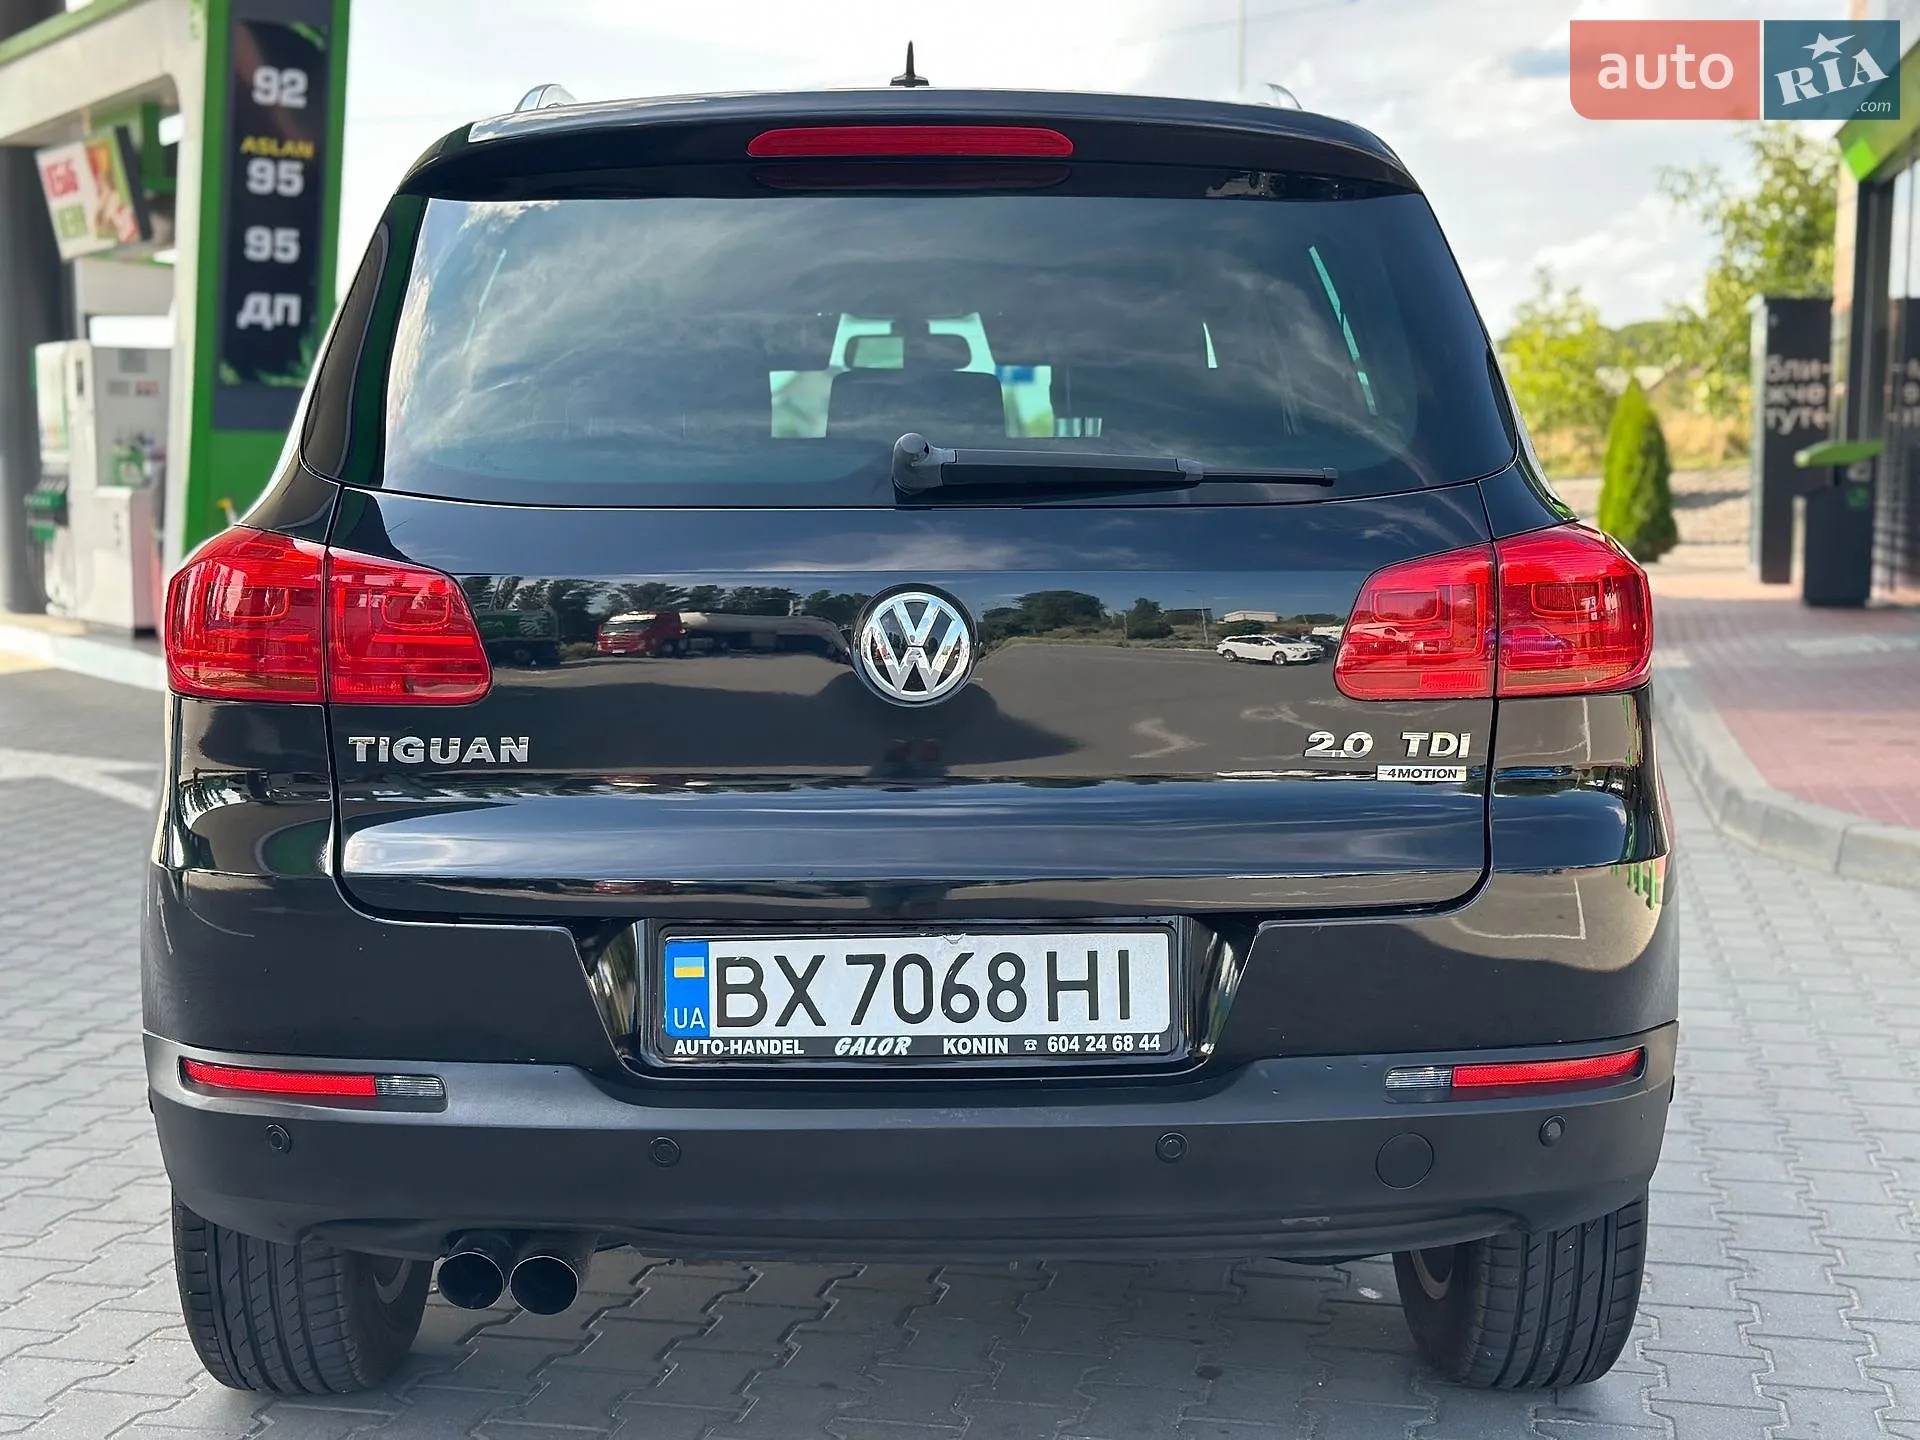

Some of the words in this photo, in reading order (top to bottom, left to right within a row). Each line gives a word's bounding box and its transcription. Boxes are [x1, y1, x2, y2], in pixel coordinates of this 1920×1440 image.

[252, 66, 309, 109] 92
[240, 135, 315, 159] ASLAN
[246, 157, 305, 197] 95
[244, 225, 301, 264] 95
[236, 292, 301, 331] ДП
[348, 736, 530, 764] TIGUAN
[1304, 731, 1374, 759] 2.0
[1402, 731, 1472, 759] TDI
[1387, 768, 1458, 779] 4MOTION
[716, 954, 827, 1028] BX
[845, 951, 1028, 1026] 7068
[673, 1007, 705, 1029] UA
[673, 1039, 805, 1056] AUTO-HANDEL
[834, 1036, 912, 1056] GALOR
[943, 1037, 1009, 1055] KONIN
[1047, 1036, 1080, 1052] 604
[1085, 1036, 1107, 1052] 24
[1112, 1035, 1134, 1052] 68
[1138, 1034, 1161, 1051] 44
